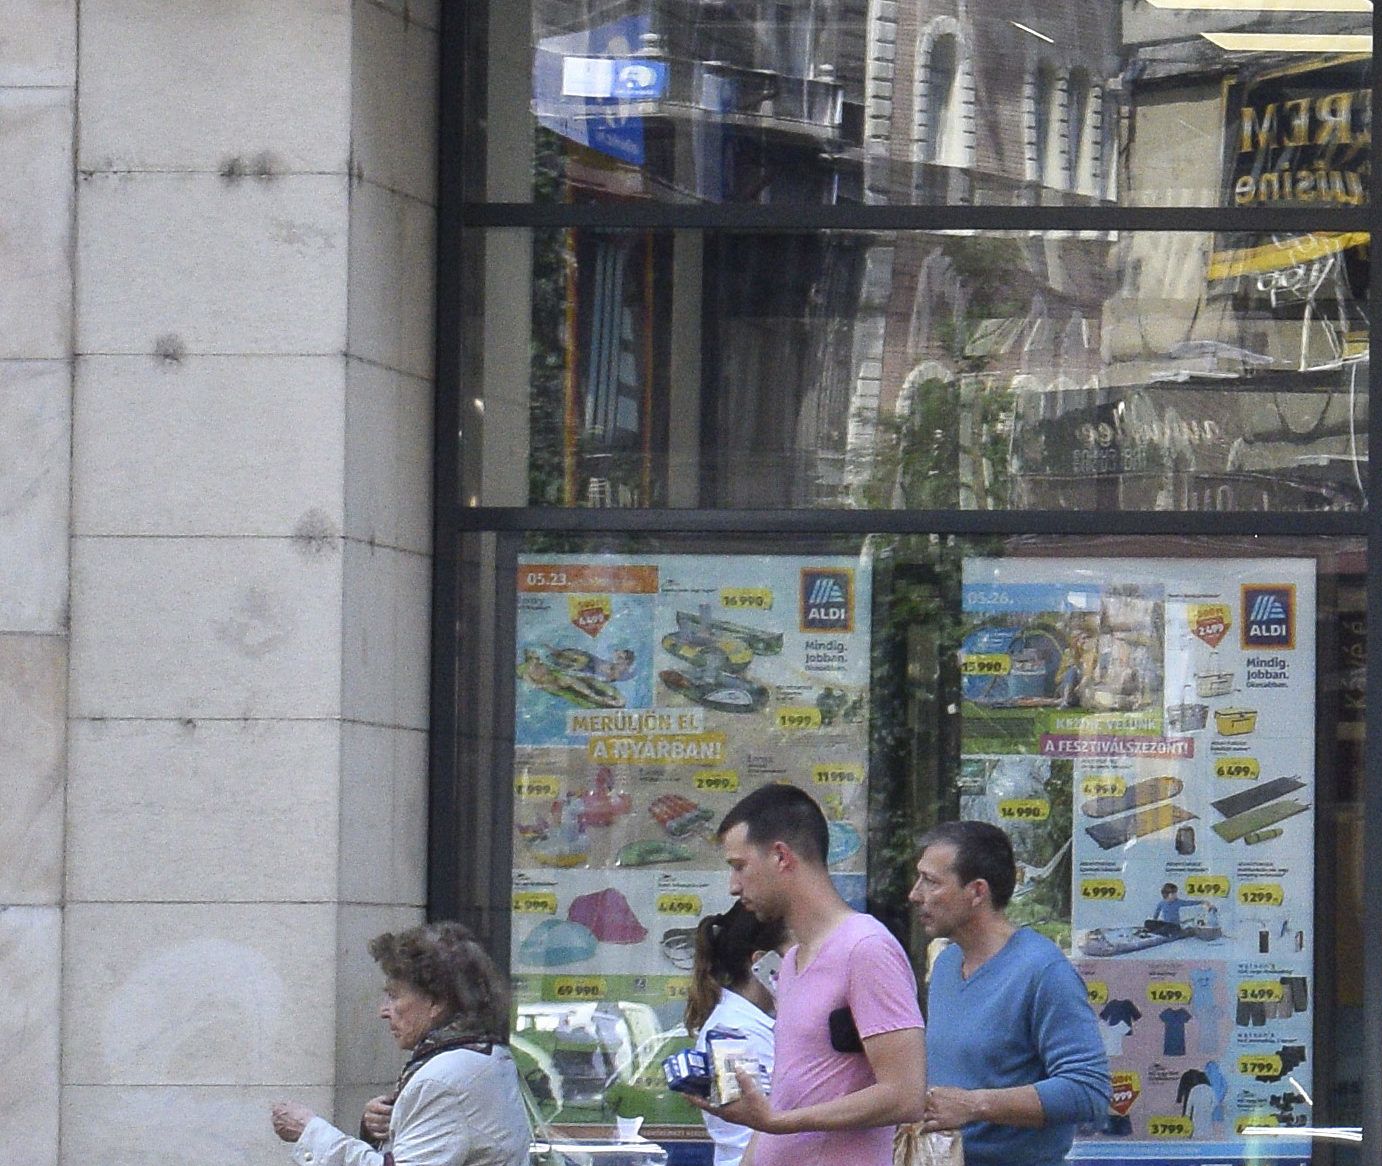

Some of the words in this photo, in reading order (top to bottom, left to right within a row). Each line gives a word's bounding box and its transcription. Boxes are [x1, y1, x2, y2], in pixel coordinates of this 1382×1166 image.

[807, 608, 846, 621] ALDI
[1249, 623, 1288, 637] ALDI
[805, 639, 848, 654] Mindig.
[1246, 656, 1290, 670] Mindig.
[1246, 669, 1290, 682] Jobban.
[593, 742, 610, 760] A
[1044, 740, 1056, 753] A
